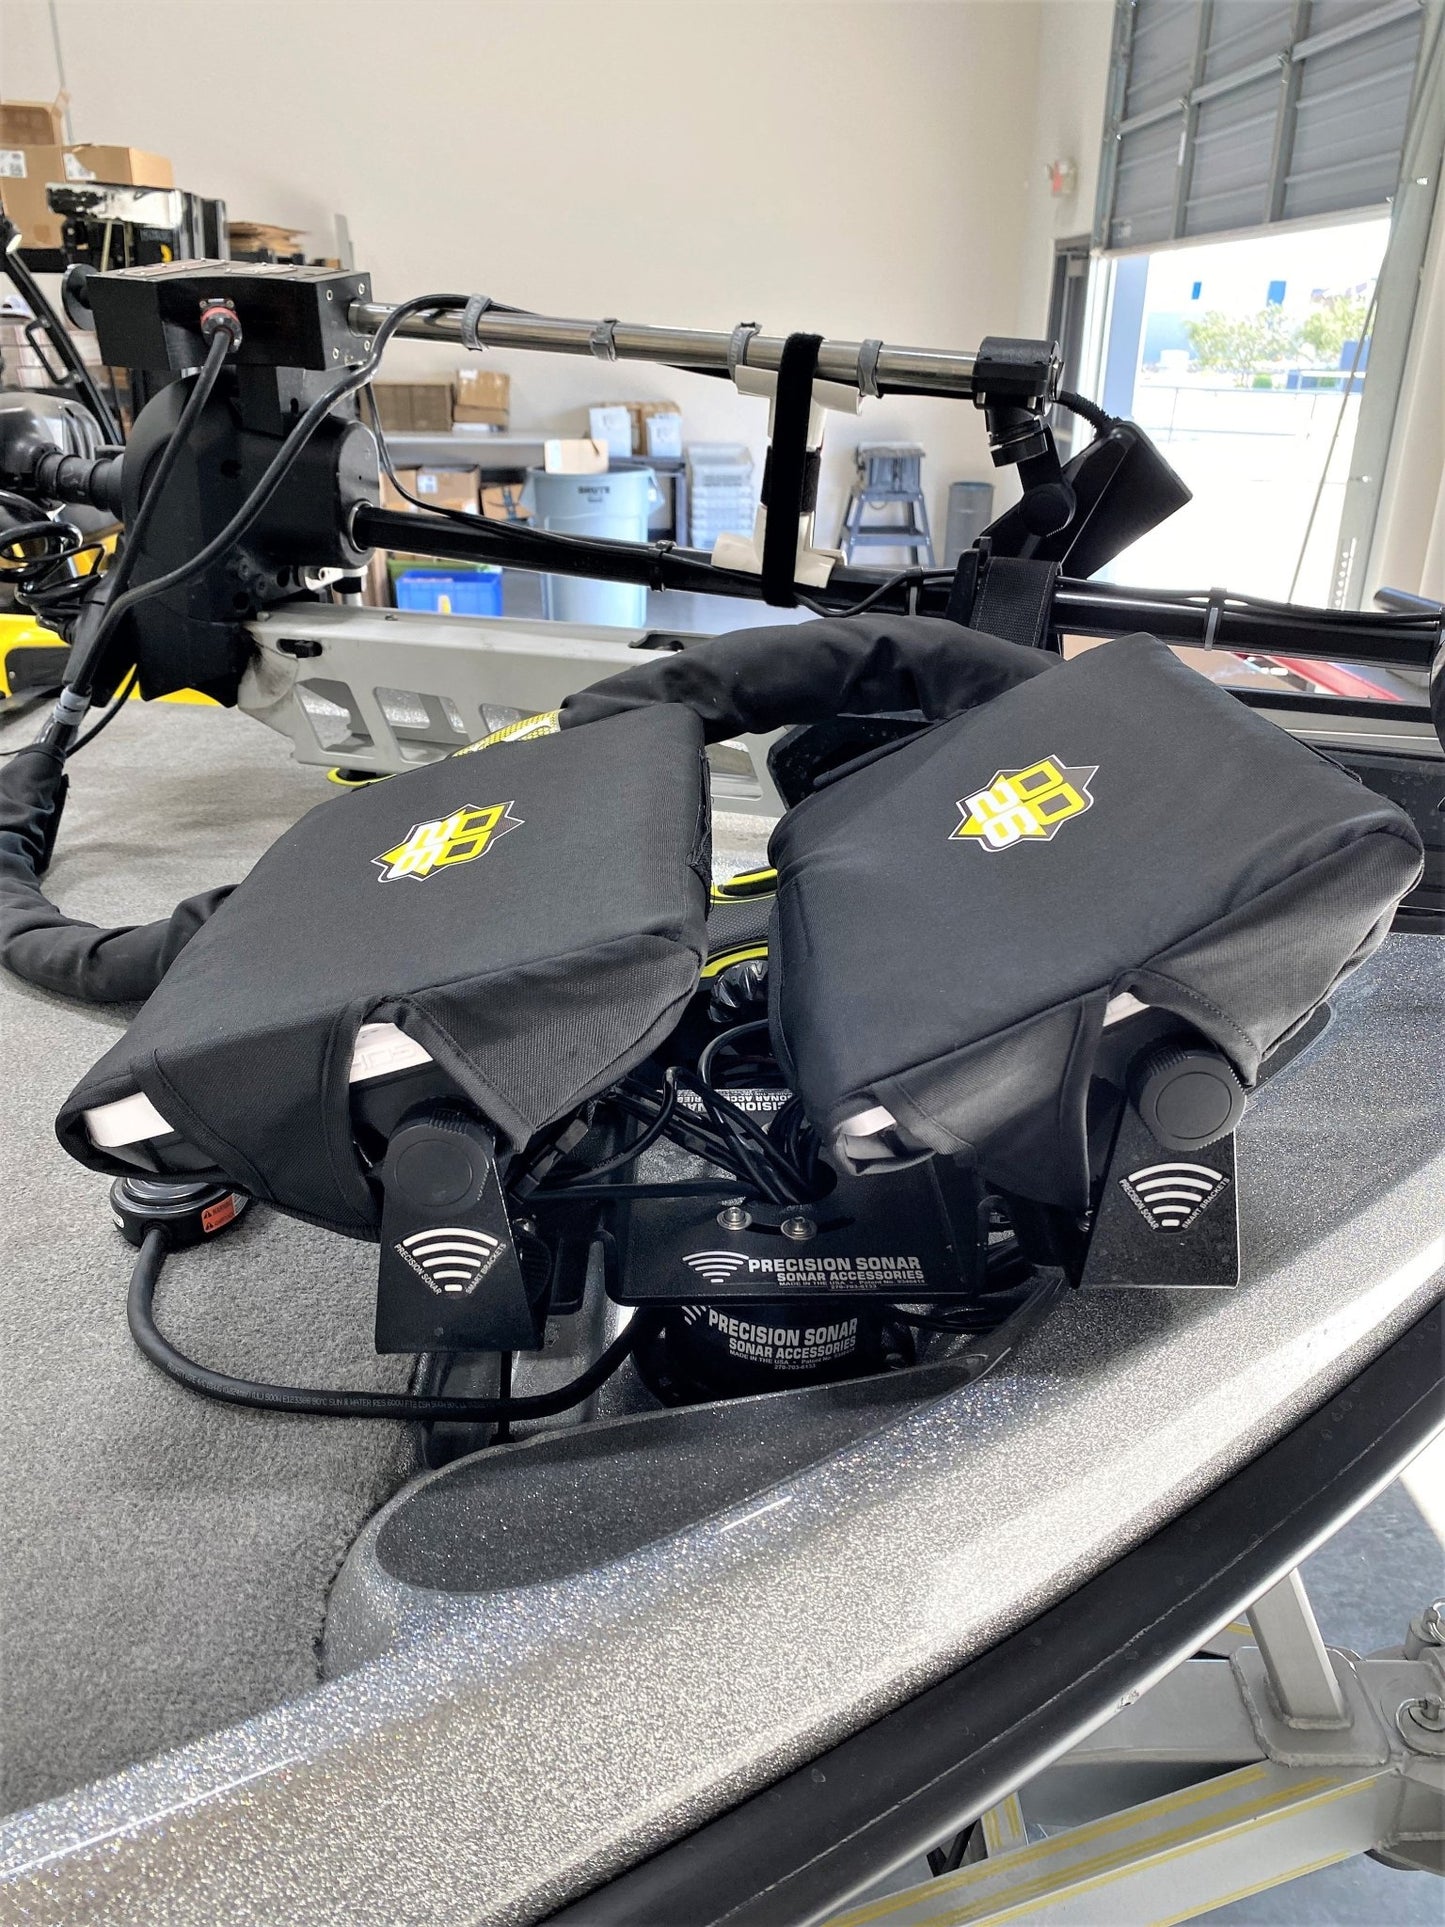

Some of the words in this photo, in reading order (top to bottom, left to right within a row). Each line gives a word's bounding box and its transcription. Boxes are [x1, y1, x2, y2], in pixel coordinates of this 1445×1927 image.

[1119, 1178, 1145, 1211] PRECISION
[1140, 1208, 1160, 1230] SONAR
[1181, 1207, 1202, 1229] SMART
[1200, 1177, 1231, 1209] BRACKETS
[394, 1243, 424, 1275] PRECISION
[421, 1273, 442, 1295] SONAR
[465, 1273, 484, 1295] SMART
[480, 1242, 507, 1275] BRACKETS
[748, 1257, 851, 1273] PRECISION
[855, 1256, 921, 1271] SONAR
[776, 1272, 826, 1282] SONAR
[829, 1270, 924, 1282] ACCESSORIES
[708, 1308, 800, 1346] PRECISION
[803, 1317, 858, 1346] SONAR
[728, 1337, 773, 1358] SONAR
[775, 1335, 856, 1359] ACCESSORIES
[729, 1349, 749, 1360] MADE
[372, 1398, 386, 1407] RES
